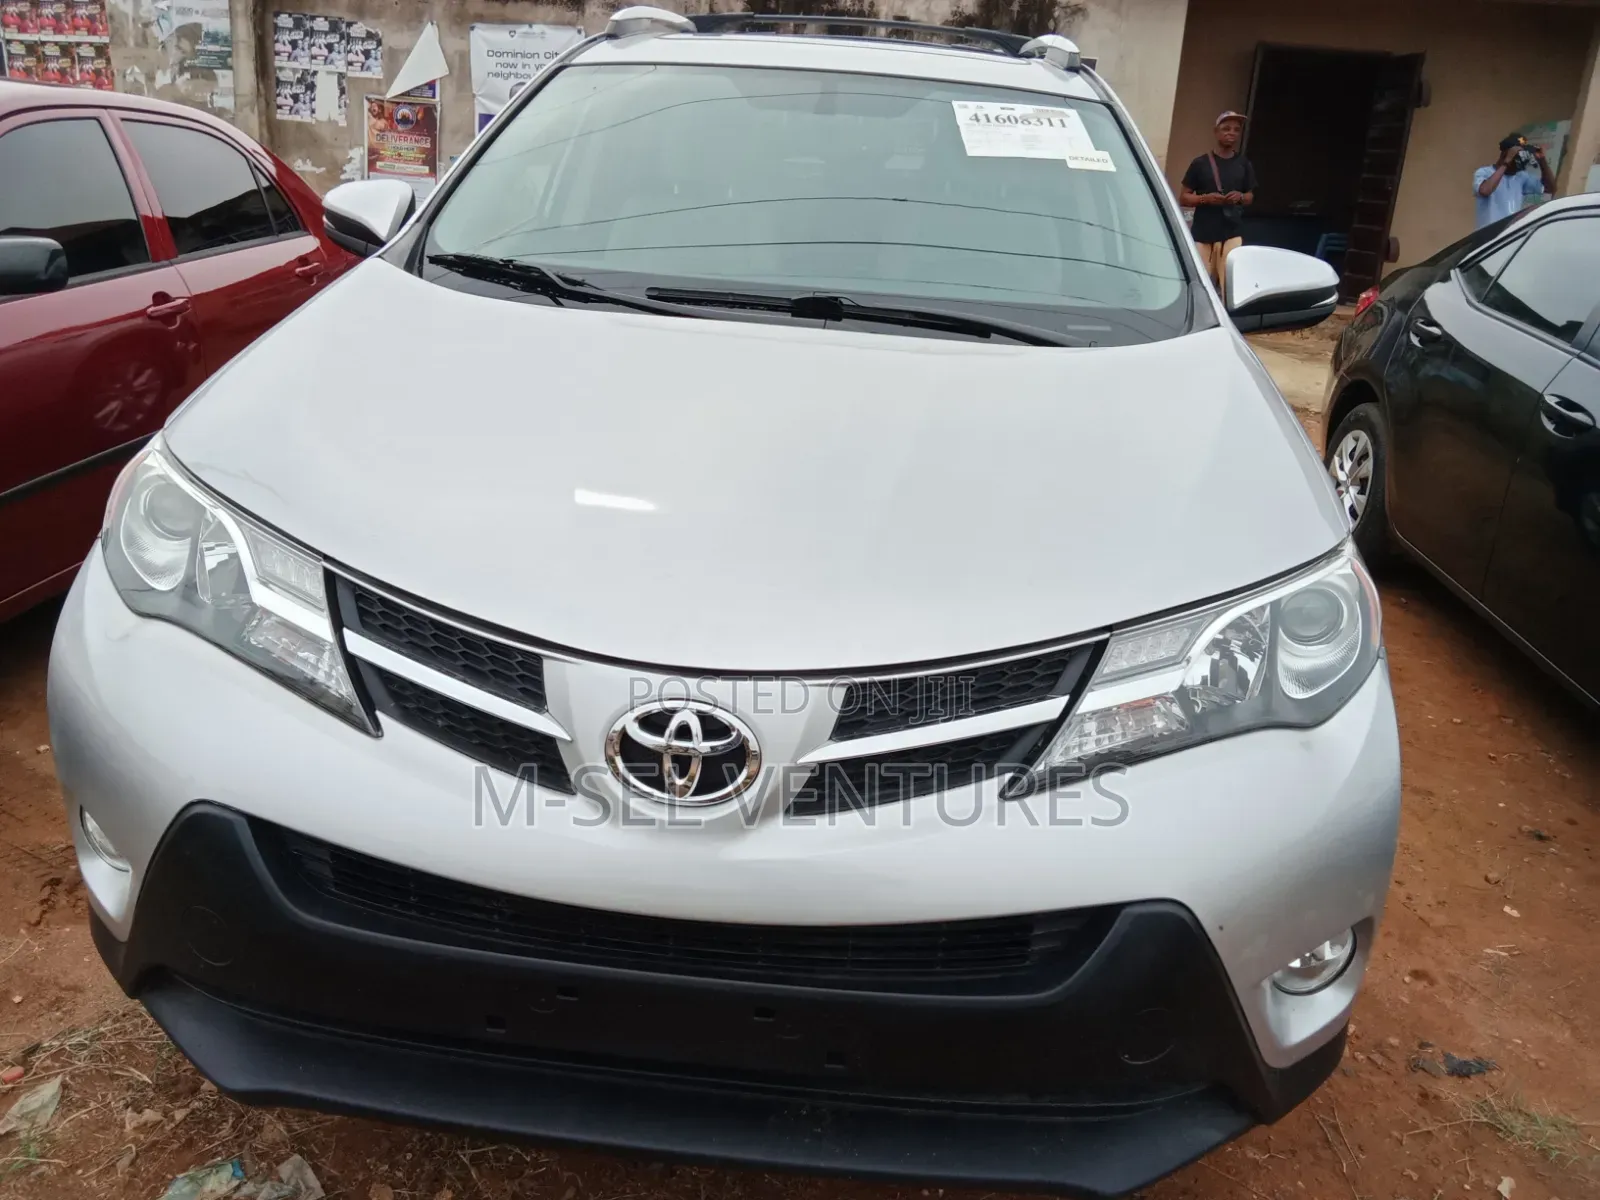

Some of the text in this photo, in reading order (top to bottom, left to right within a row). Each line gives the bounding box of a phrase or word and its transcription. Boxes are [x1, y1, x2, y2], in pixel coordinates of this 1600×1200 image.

[486, 49, 560, 60] Dominion Cit
[495, 61, 547, 72] now in yo
[487, 71, 533, 81] neighbou
[375, 133, 431, 148] DELIVERANCE
[1068, 155, 1109, 164] DETAILED
